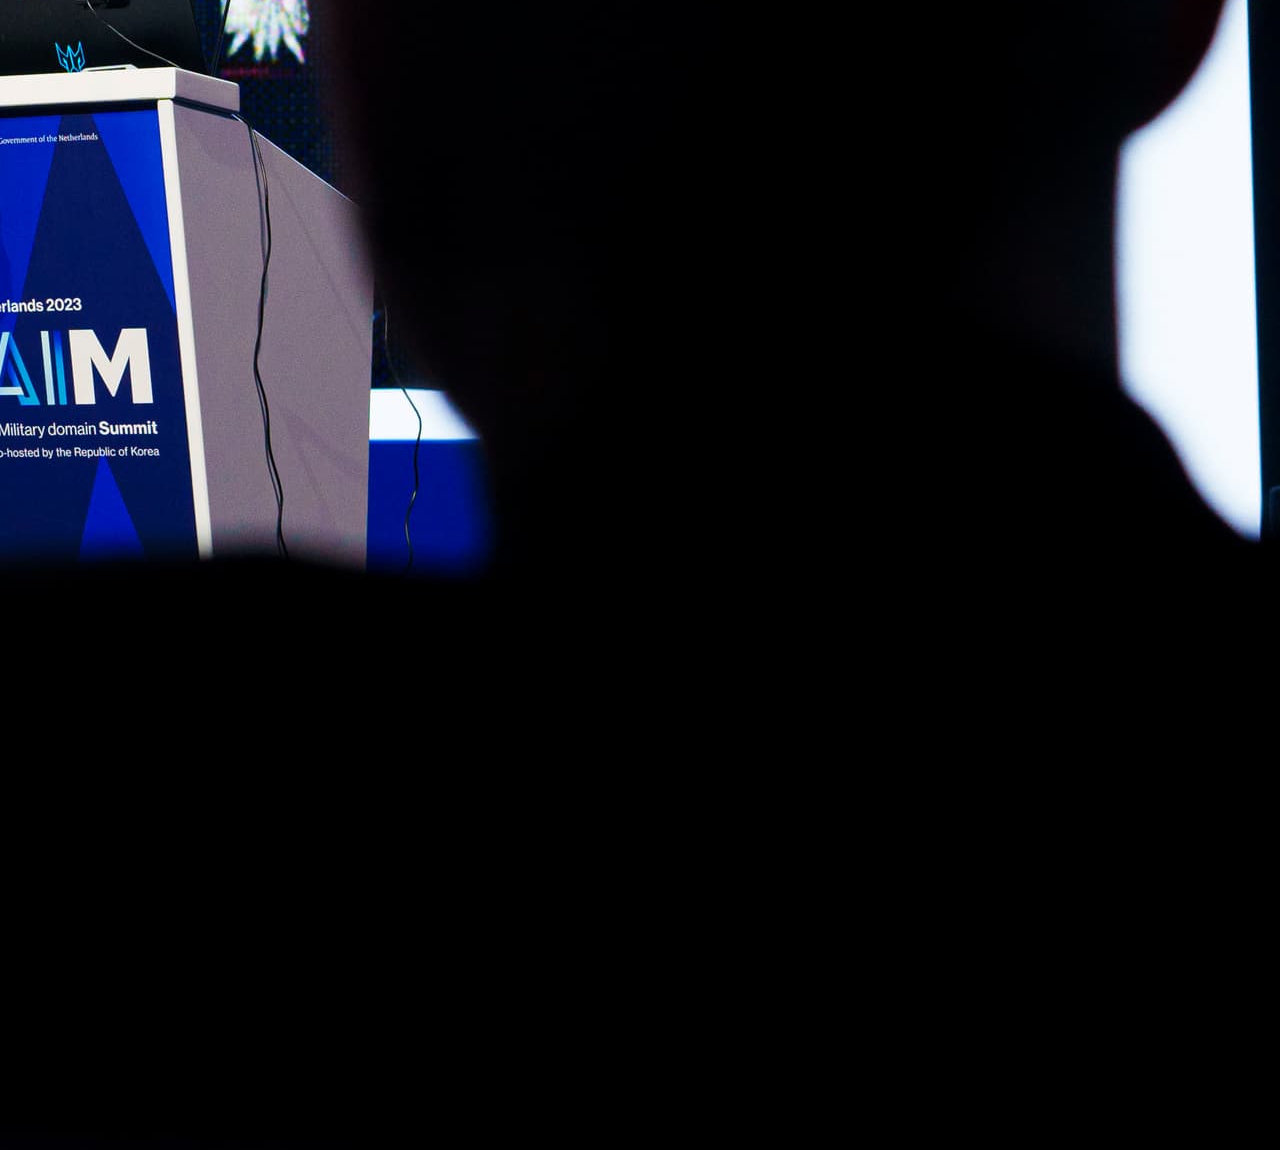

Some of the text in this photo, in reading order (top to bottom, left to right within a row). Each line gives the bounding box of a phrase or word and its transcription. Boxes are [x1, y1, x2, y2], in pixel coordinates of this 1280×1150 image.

[38, 135, 46, 143] of
[46, 134, 58, 142] the
[58, 132, 99, 142] Netherlands
[45, 297, 83, 311] 2023
[47, 422, 97, 436] domain
[98, 420, 159, 436] Summit
[41, 447, 54, 459] by
[56, 447, 72, 458] the
[73, 446, 117, 459] Republic
[118, 446, 128, 457] of
[130, 446, 160, 457] Korea
